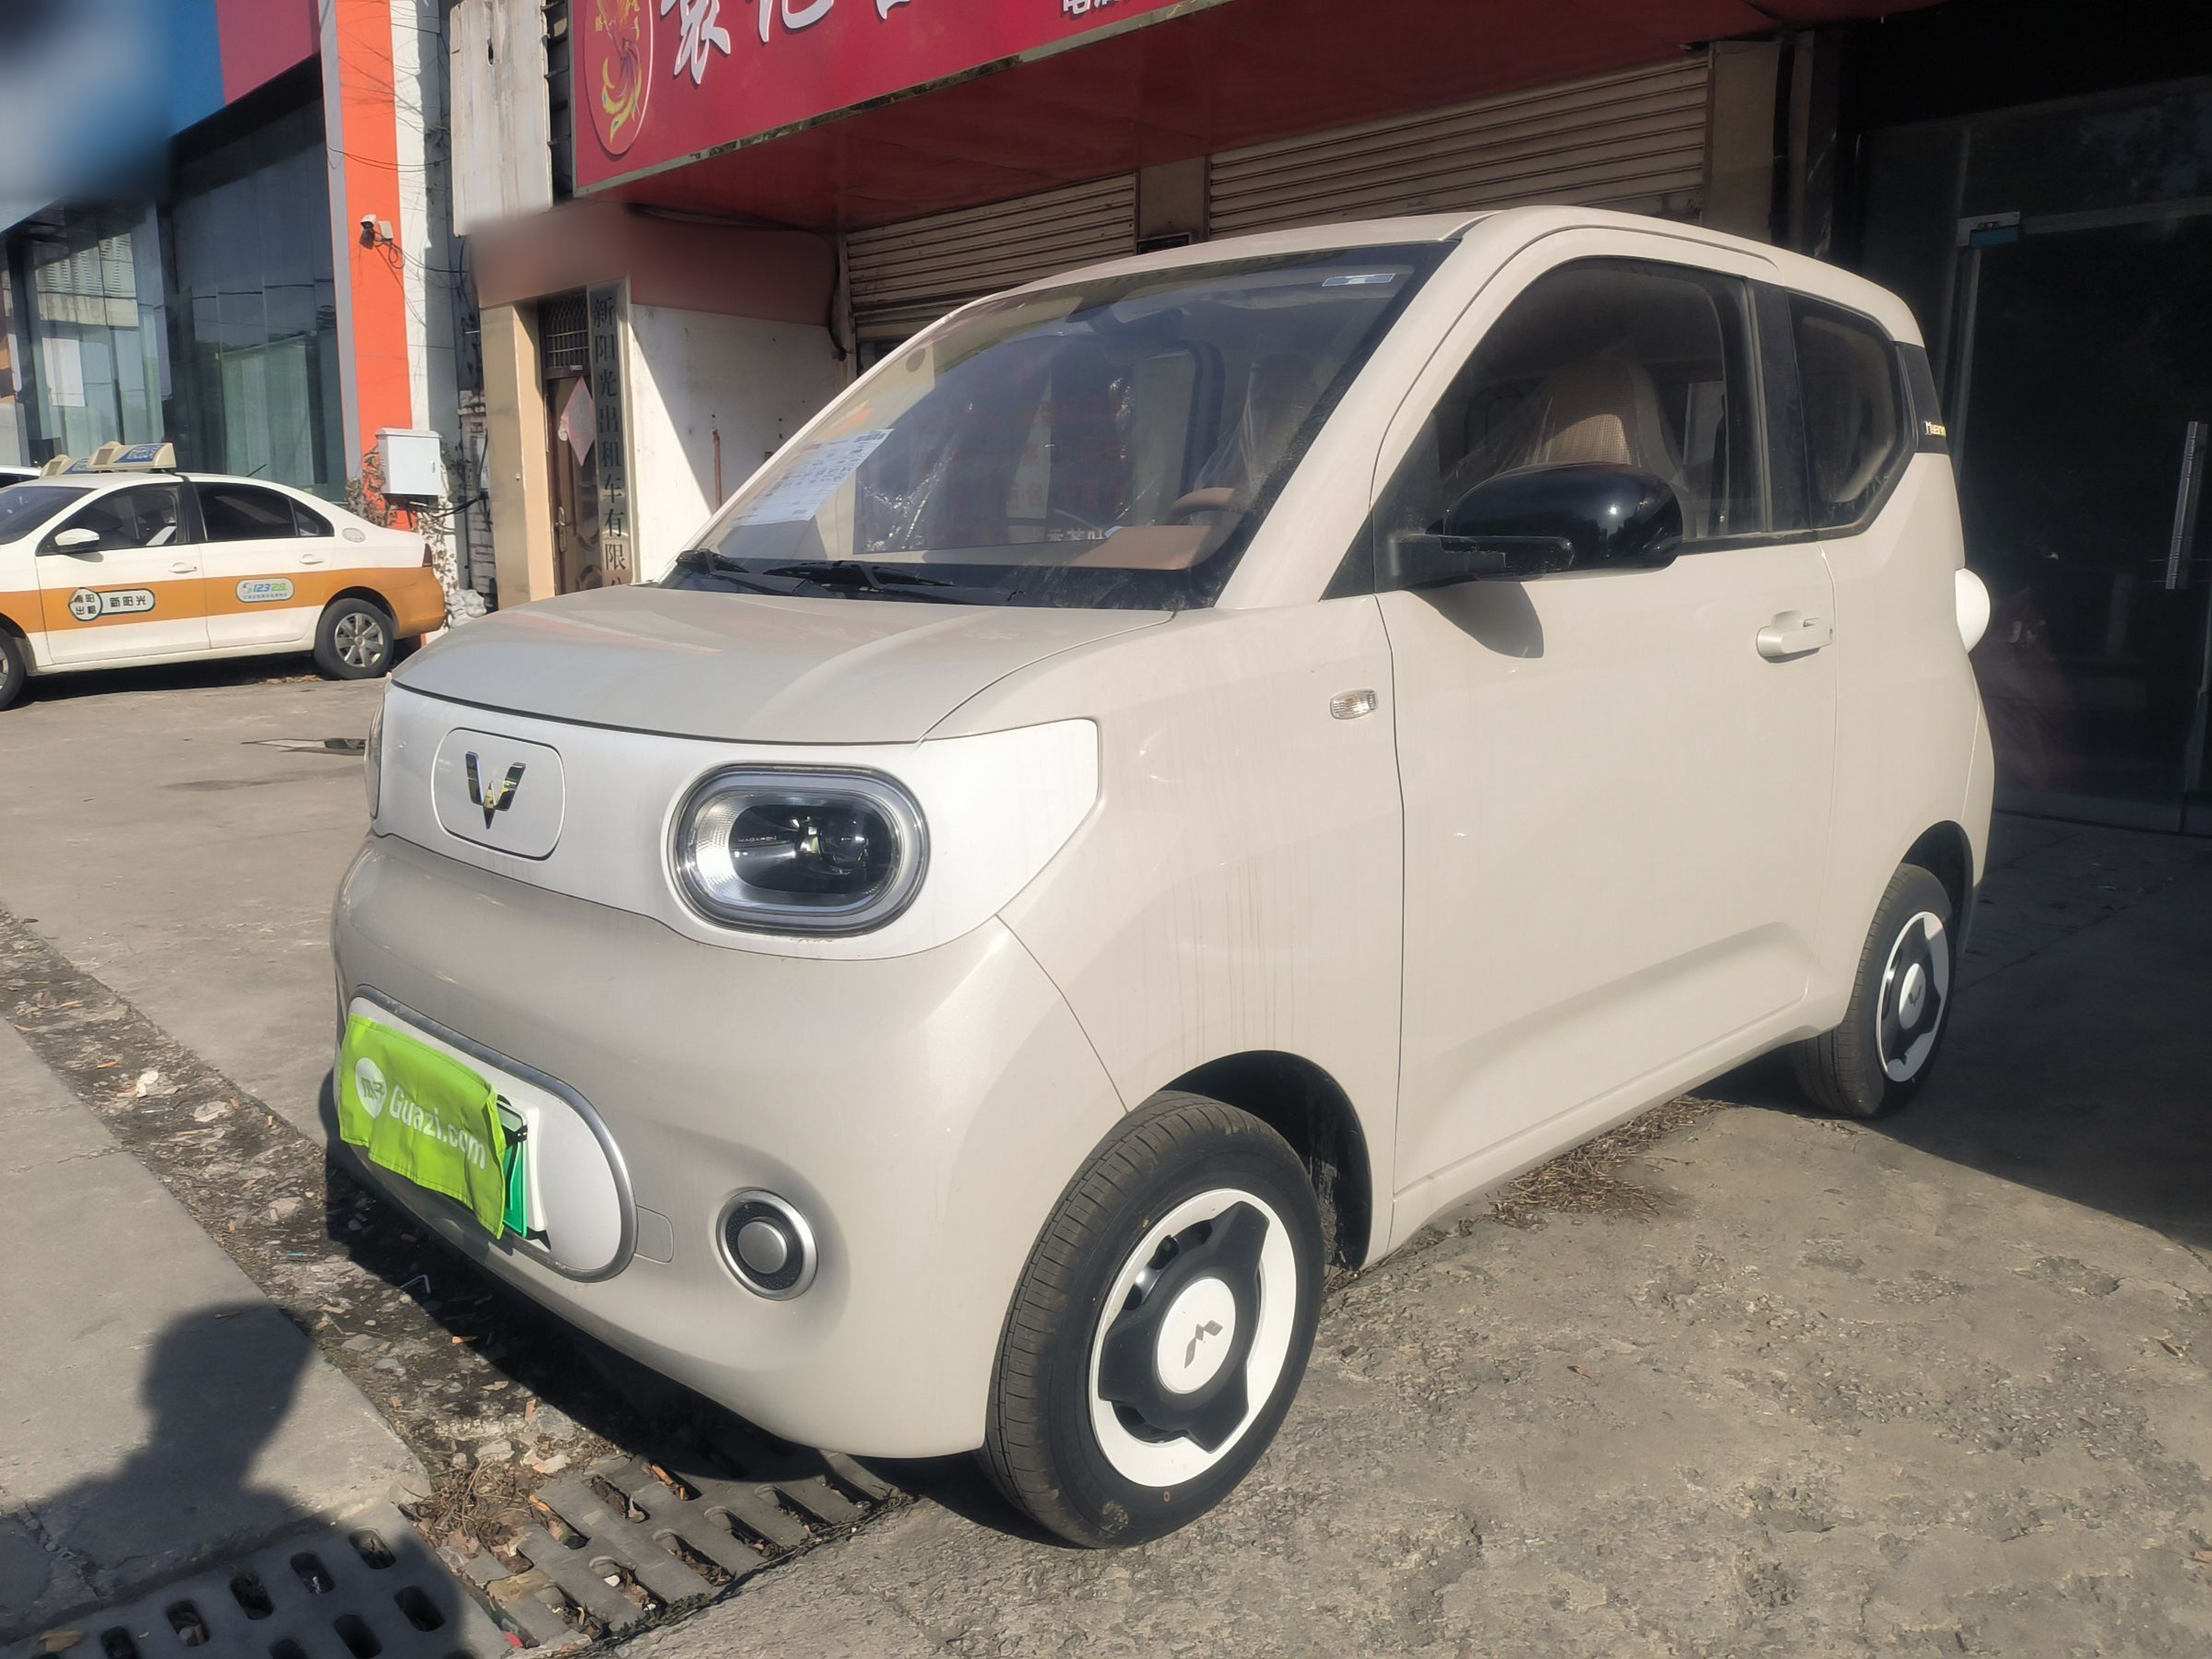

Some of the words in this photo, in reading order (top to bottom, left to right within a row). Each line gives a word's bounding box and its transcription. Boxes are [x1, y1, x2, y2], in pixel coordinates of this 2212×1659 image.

[592, 296, 626, 586] 新阳光出租车有限
[389, 1085, 487, 1169] Guazi.com
